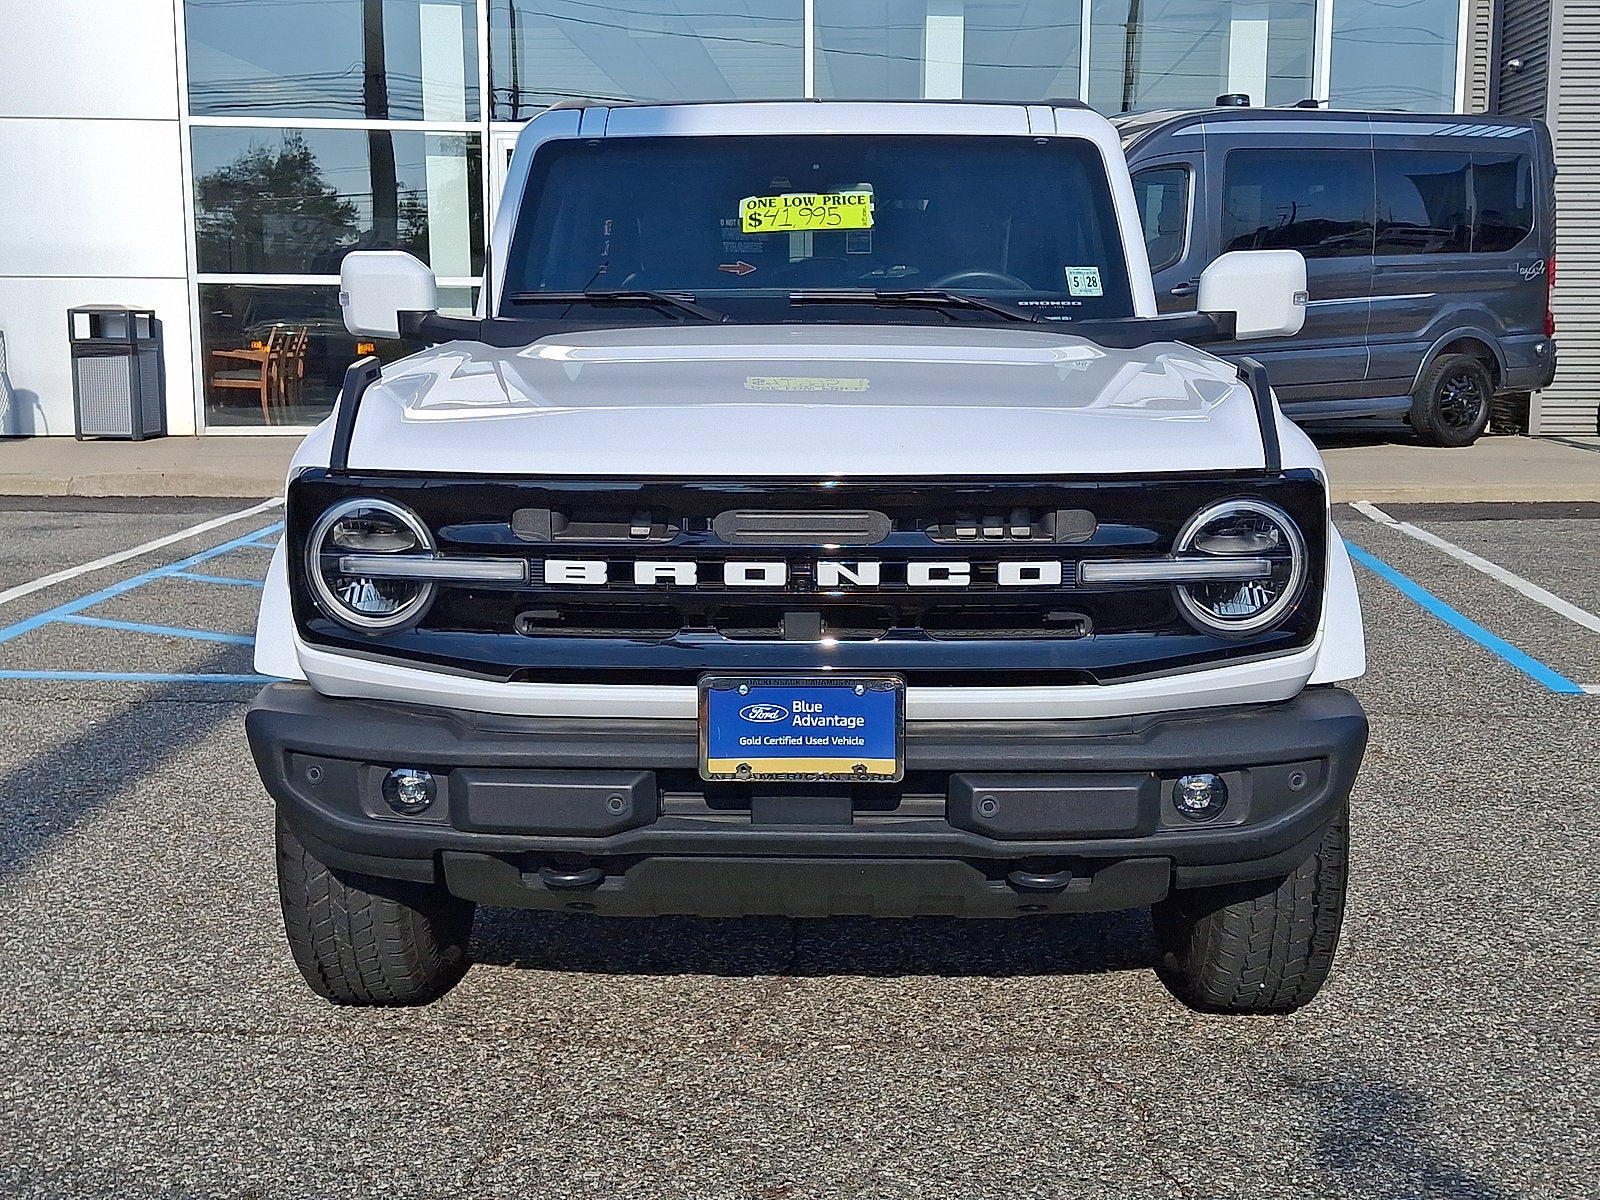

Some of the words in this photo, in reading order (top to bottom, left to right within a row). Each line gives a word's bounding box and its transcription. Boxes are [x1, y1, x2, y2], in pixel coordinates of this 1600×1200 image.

[747, 199, 776, 210] ONE
[784, 196, 816, 207] LOW
[823, 195, 866, 205] PRICE
[748, 206, 842, 229] $41,995
[1073, 276, 1080, 288] 5
[1086, 276, 1098, 288] 28
[544, 559, 1062, 587] BRONCO
[747, 705, 780, 721] Ford
[792, 701, 823, 713] Blue
[792, 714, 865, 729] Advantage
[739, 736, 762, 746] Gold
[763, 735, 803, 746] Certified
[805, 735, 829, 746] Used
[831, 735, 865, 746] Vehicle
[749, 772, 841, 781] AMERICAN
[847, 773, 895, 781] FORD
